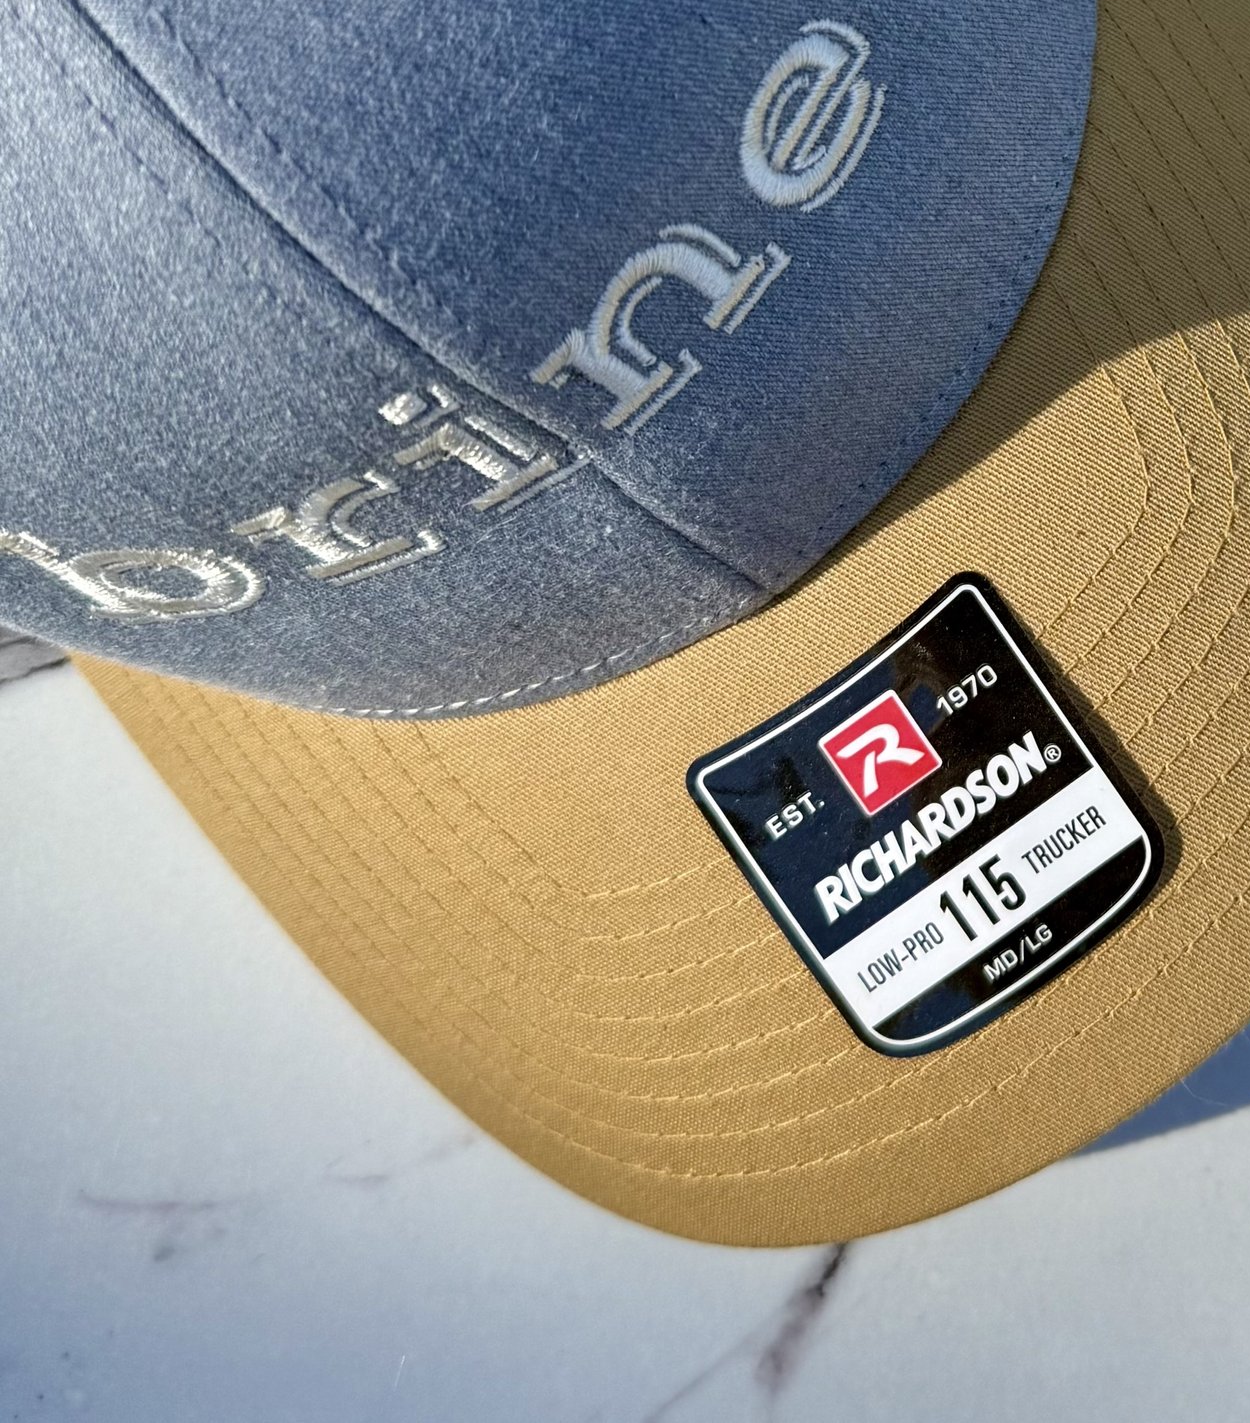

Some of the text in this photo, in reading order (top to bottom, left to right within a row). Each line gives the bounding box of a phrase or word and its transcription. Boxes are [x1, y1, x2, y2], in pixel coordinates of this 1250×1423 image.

[0, 17, 887, 621] brine
[765, 789, 826, 840] EST.
[936, 663, 998, 718] 1970
[856, 804, 1107, 994] LOW-PRO 115 TRUCKER
[982, 923, 1053, 983] MD/LG
